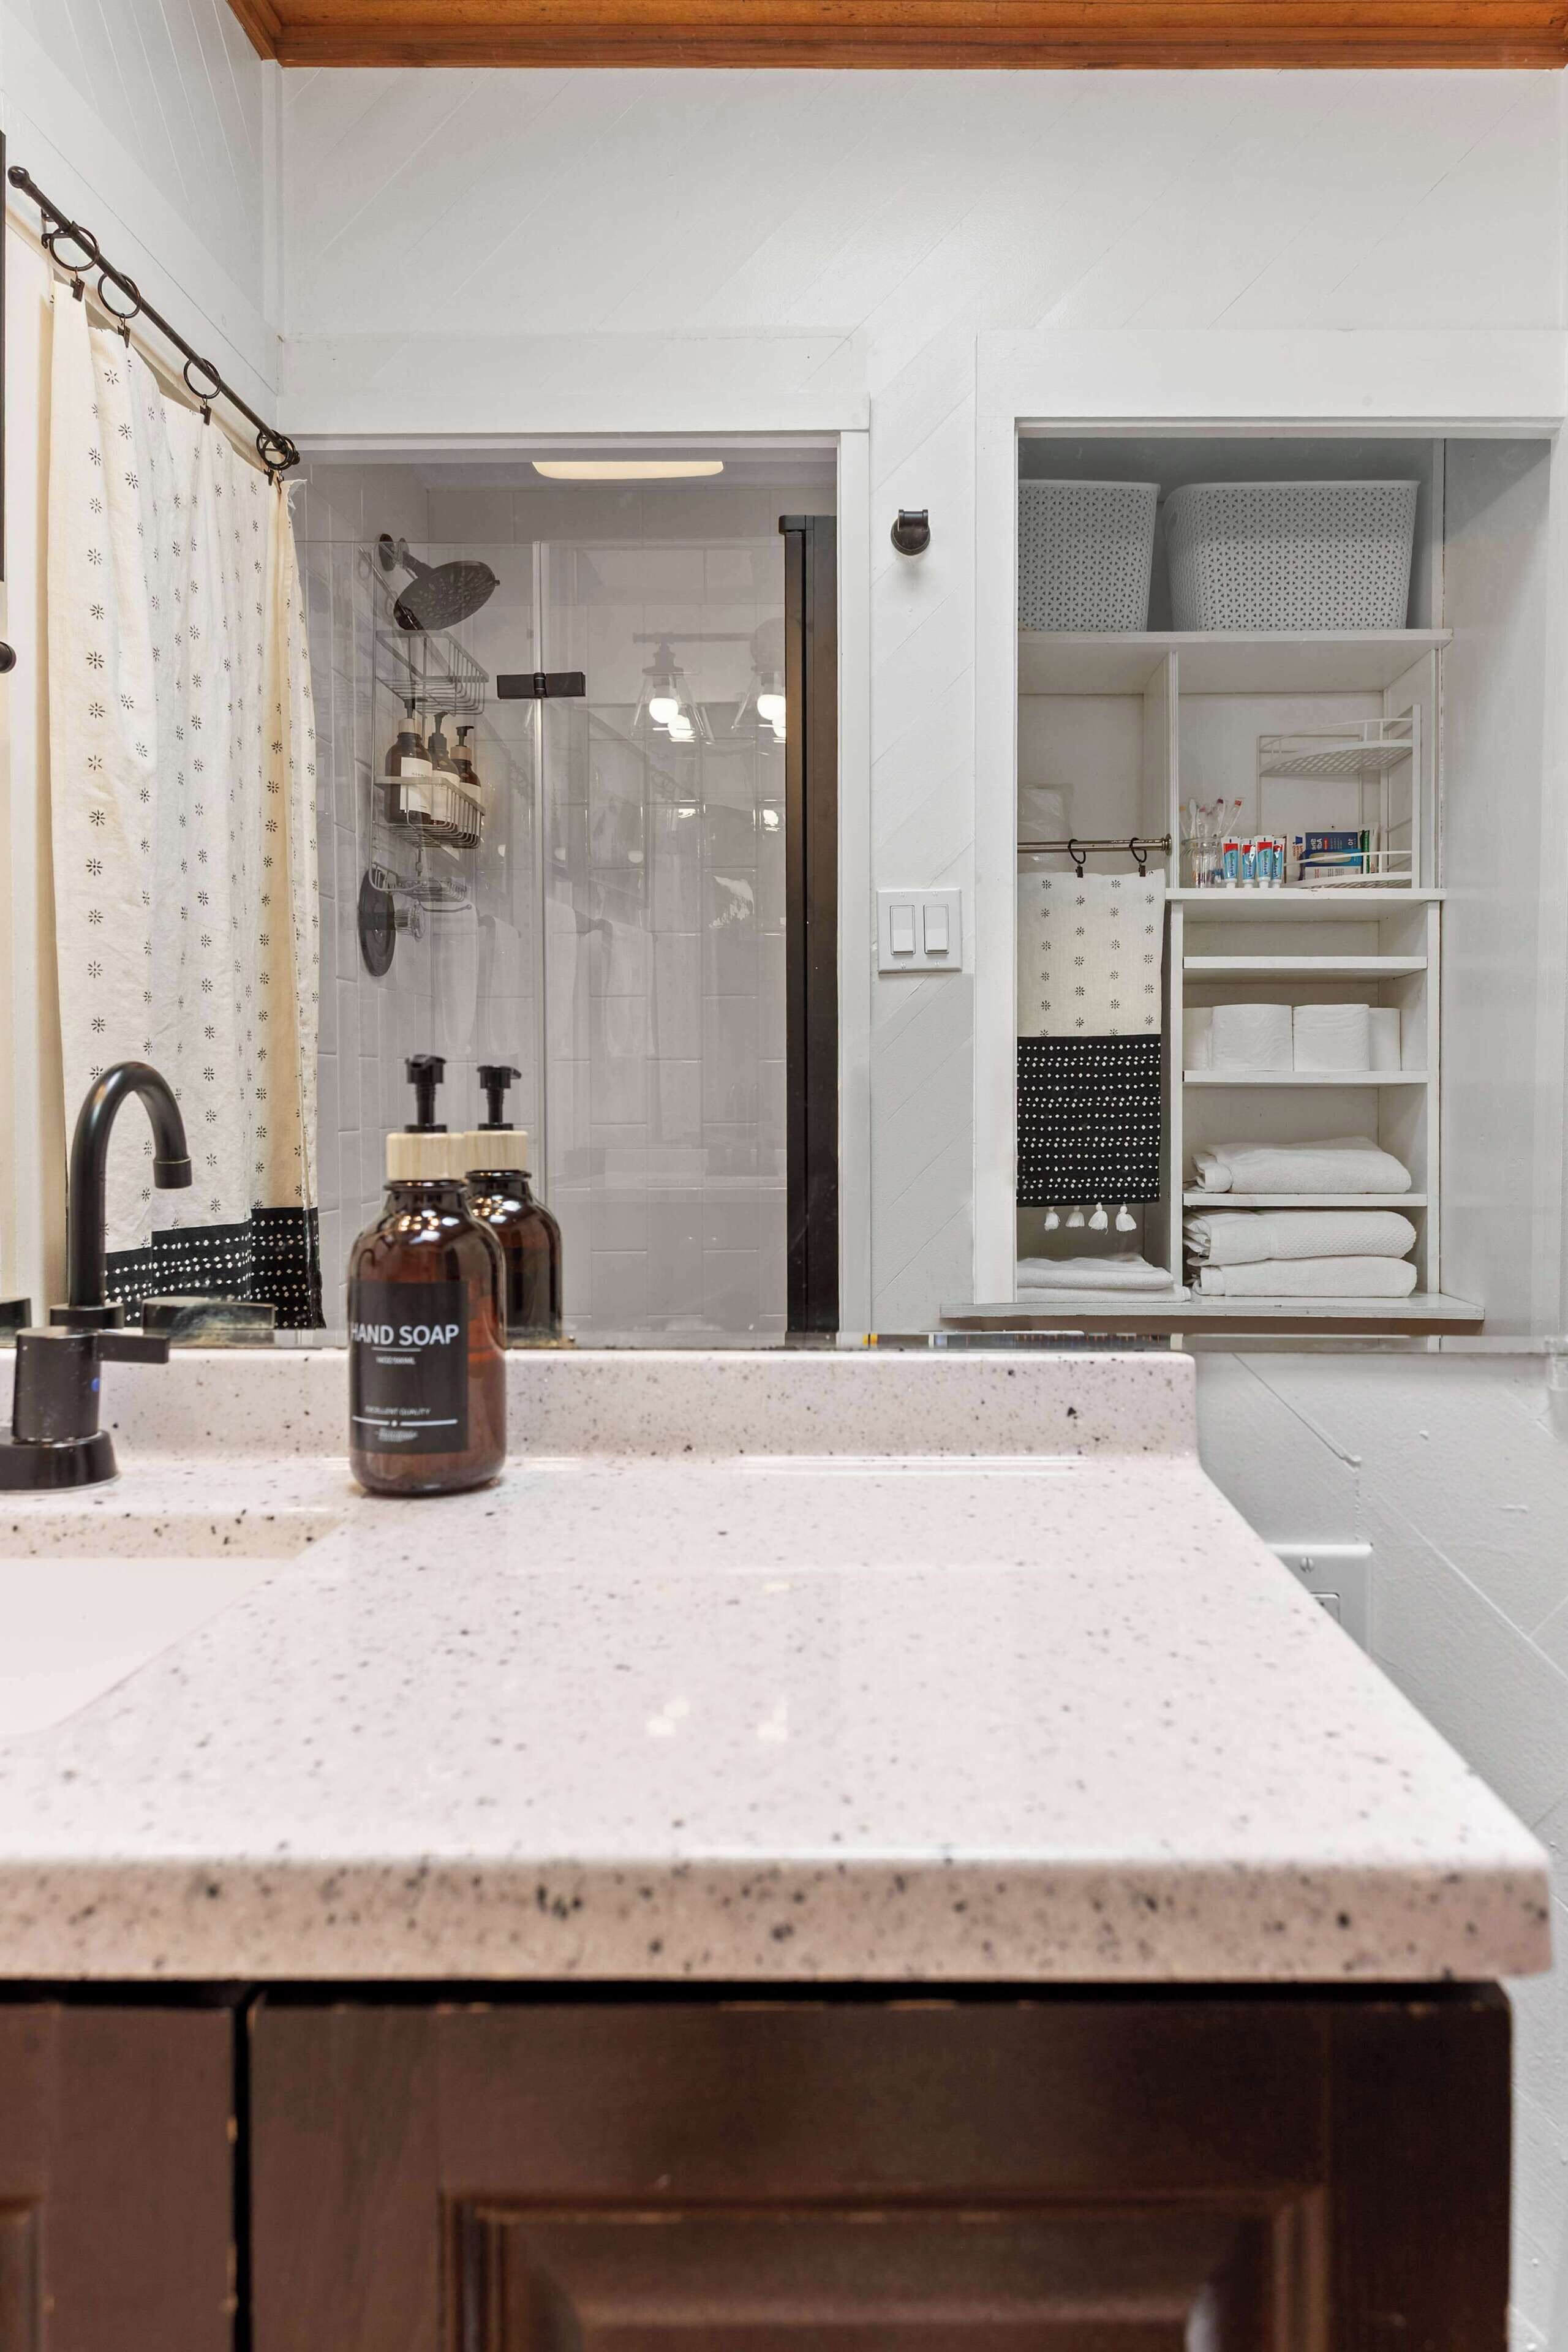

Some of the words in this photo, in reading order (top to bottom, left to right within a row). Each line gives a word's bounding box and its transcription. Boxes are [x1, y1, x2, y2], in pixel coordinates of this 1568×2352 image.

[350, 1322, 394, 1346] HAND
[399, 1324, 459, 1346] SOAP
[399, 1407, 431, 1416] QUALITY
